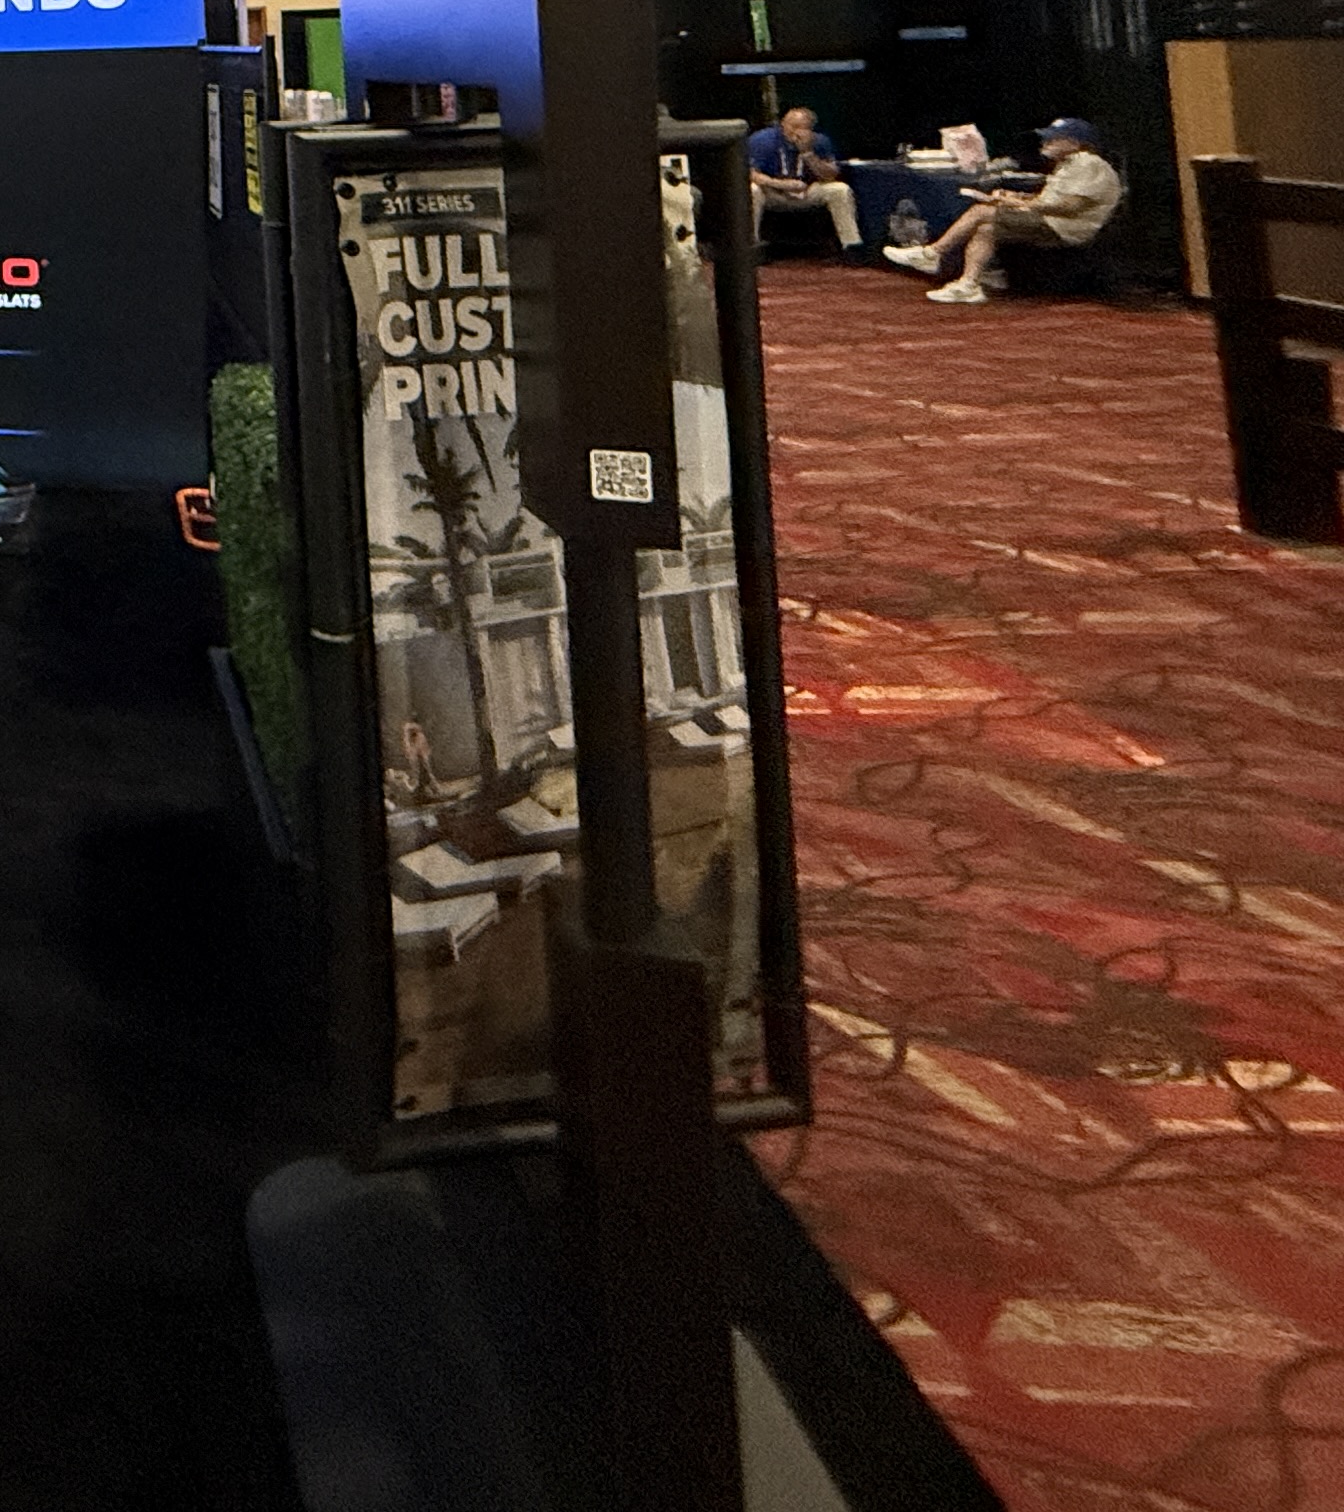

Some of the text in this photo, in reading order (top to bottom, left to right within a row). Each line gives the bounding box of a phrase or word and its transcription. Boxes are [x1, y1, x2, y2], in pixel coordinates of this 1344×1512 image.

[382, 194, 475, 215] 311 SERIES
[367, 233, 511, 293] FULL
[377, 295, 514, 358] CUST
[382, 354, 518, 422] PRIN
